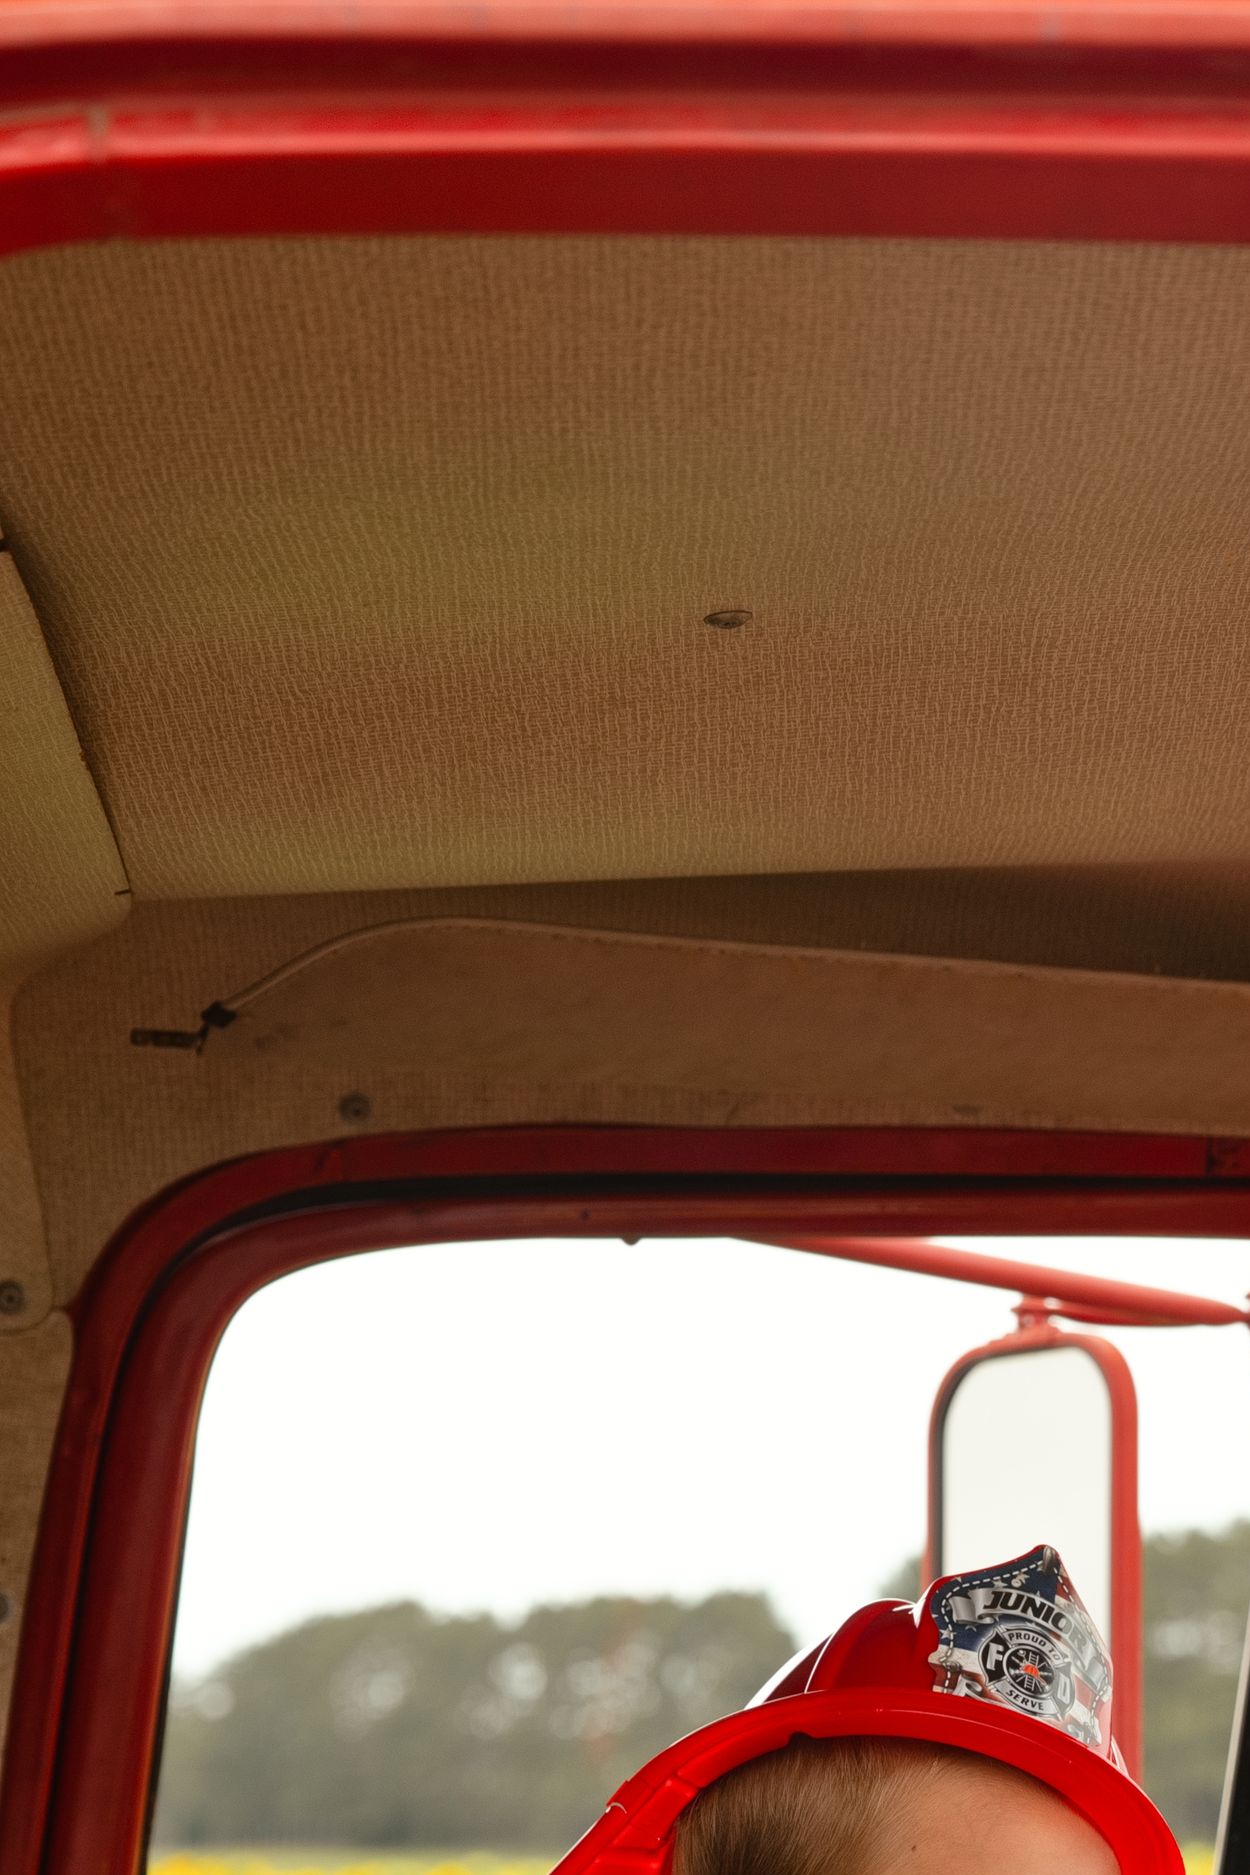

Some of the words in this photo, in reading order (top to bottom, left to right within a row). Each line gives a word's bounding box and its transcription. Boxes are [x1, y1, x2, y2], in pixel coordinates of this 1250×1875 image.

[983, 1590, 1088, 1653] JUNIOR
[1007, 1632, 1047, 1648] PROUD
[1048, 1648, 1061, 1662] TO
[986, 1642, 1004, 1671] F
[1058, 1674, 1071, 1704] D
[1006, 1689, 1044, 1711] SERVE
